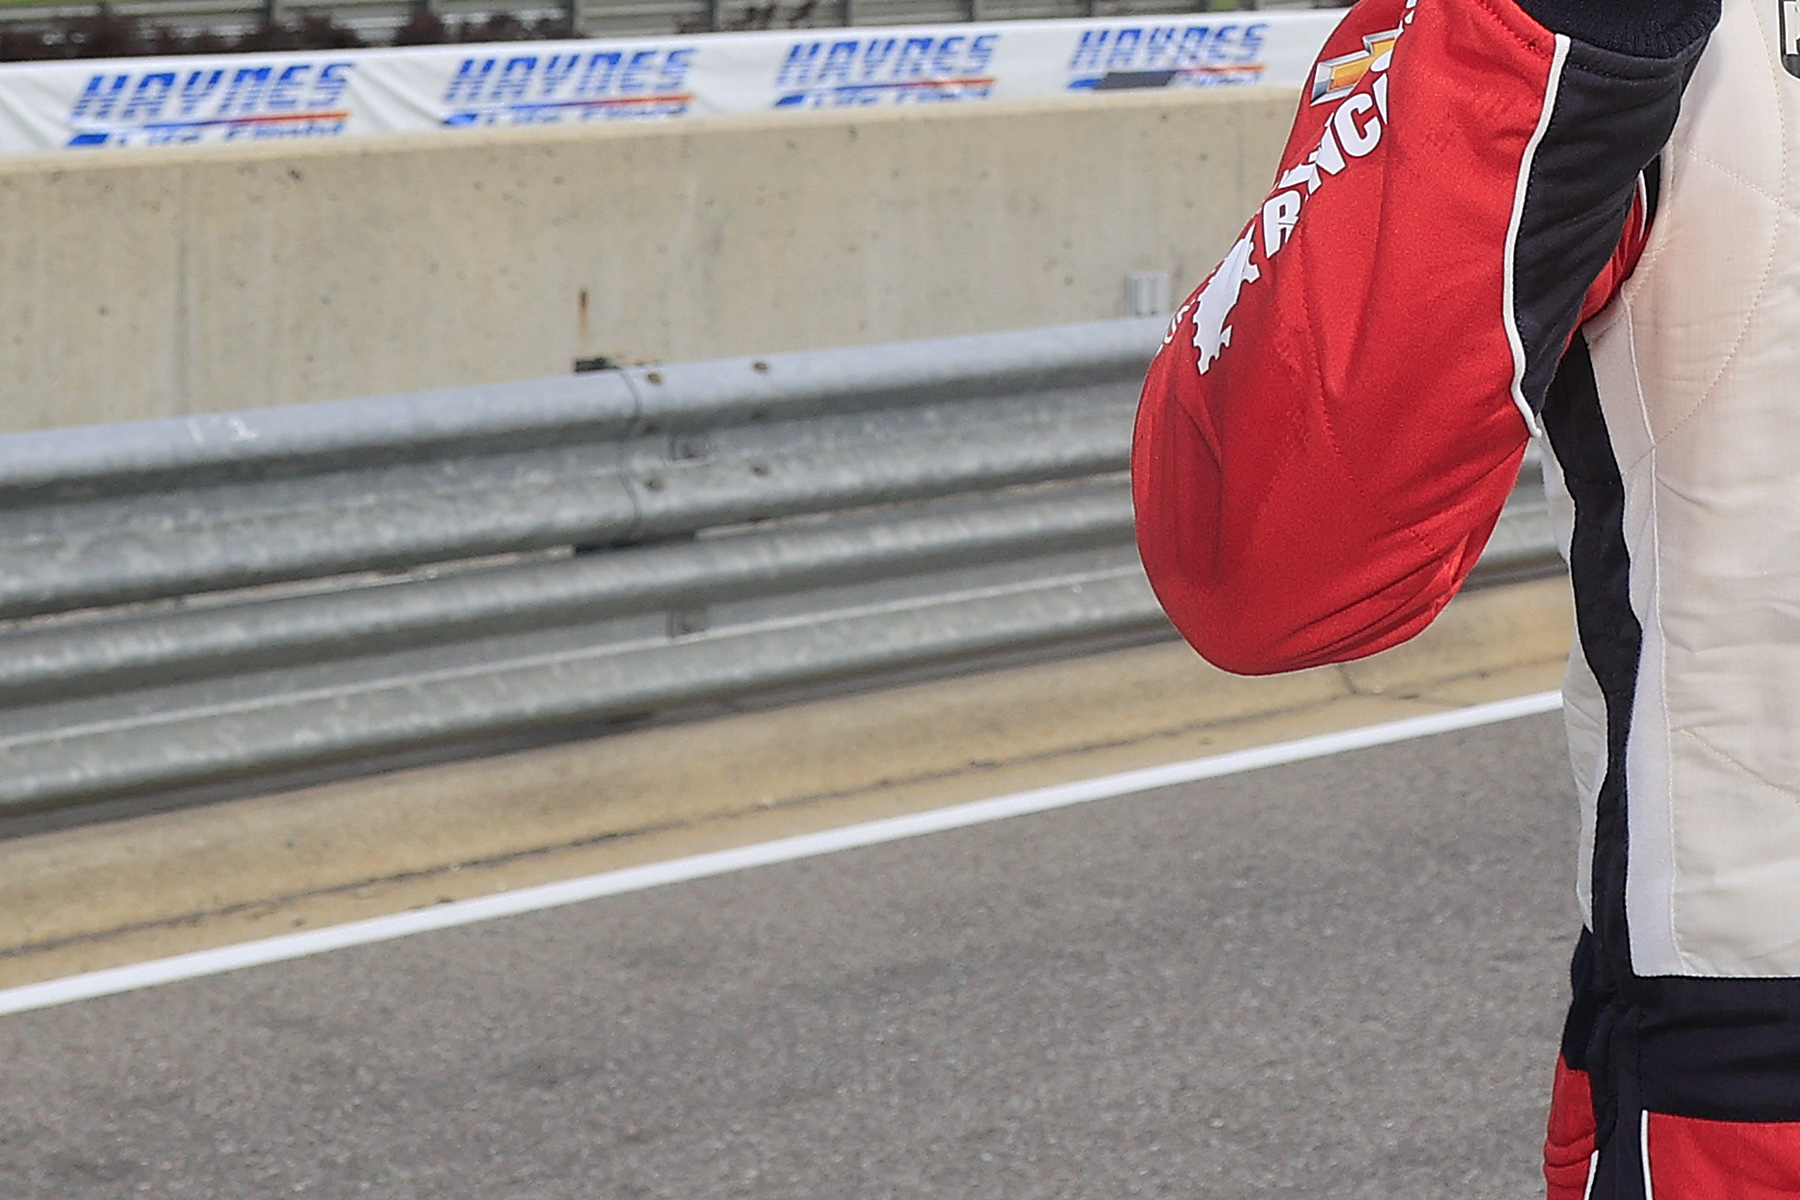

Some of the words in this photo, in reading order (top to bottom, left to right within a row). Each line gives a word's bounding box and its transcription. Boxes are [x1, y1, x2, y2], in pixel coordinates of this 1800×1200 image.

[776, 34, 999, 87] HAYNES
[1069, 23, 1268, 70] HAYNES
[70, 63, 354, 119] HAYNES
[442, 47, 696, 102] HAYNES
